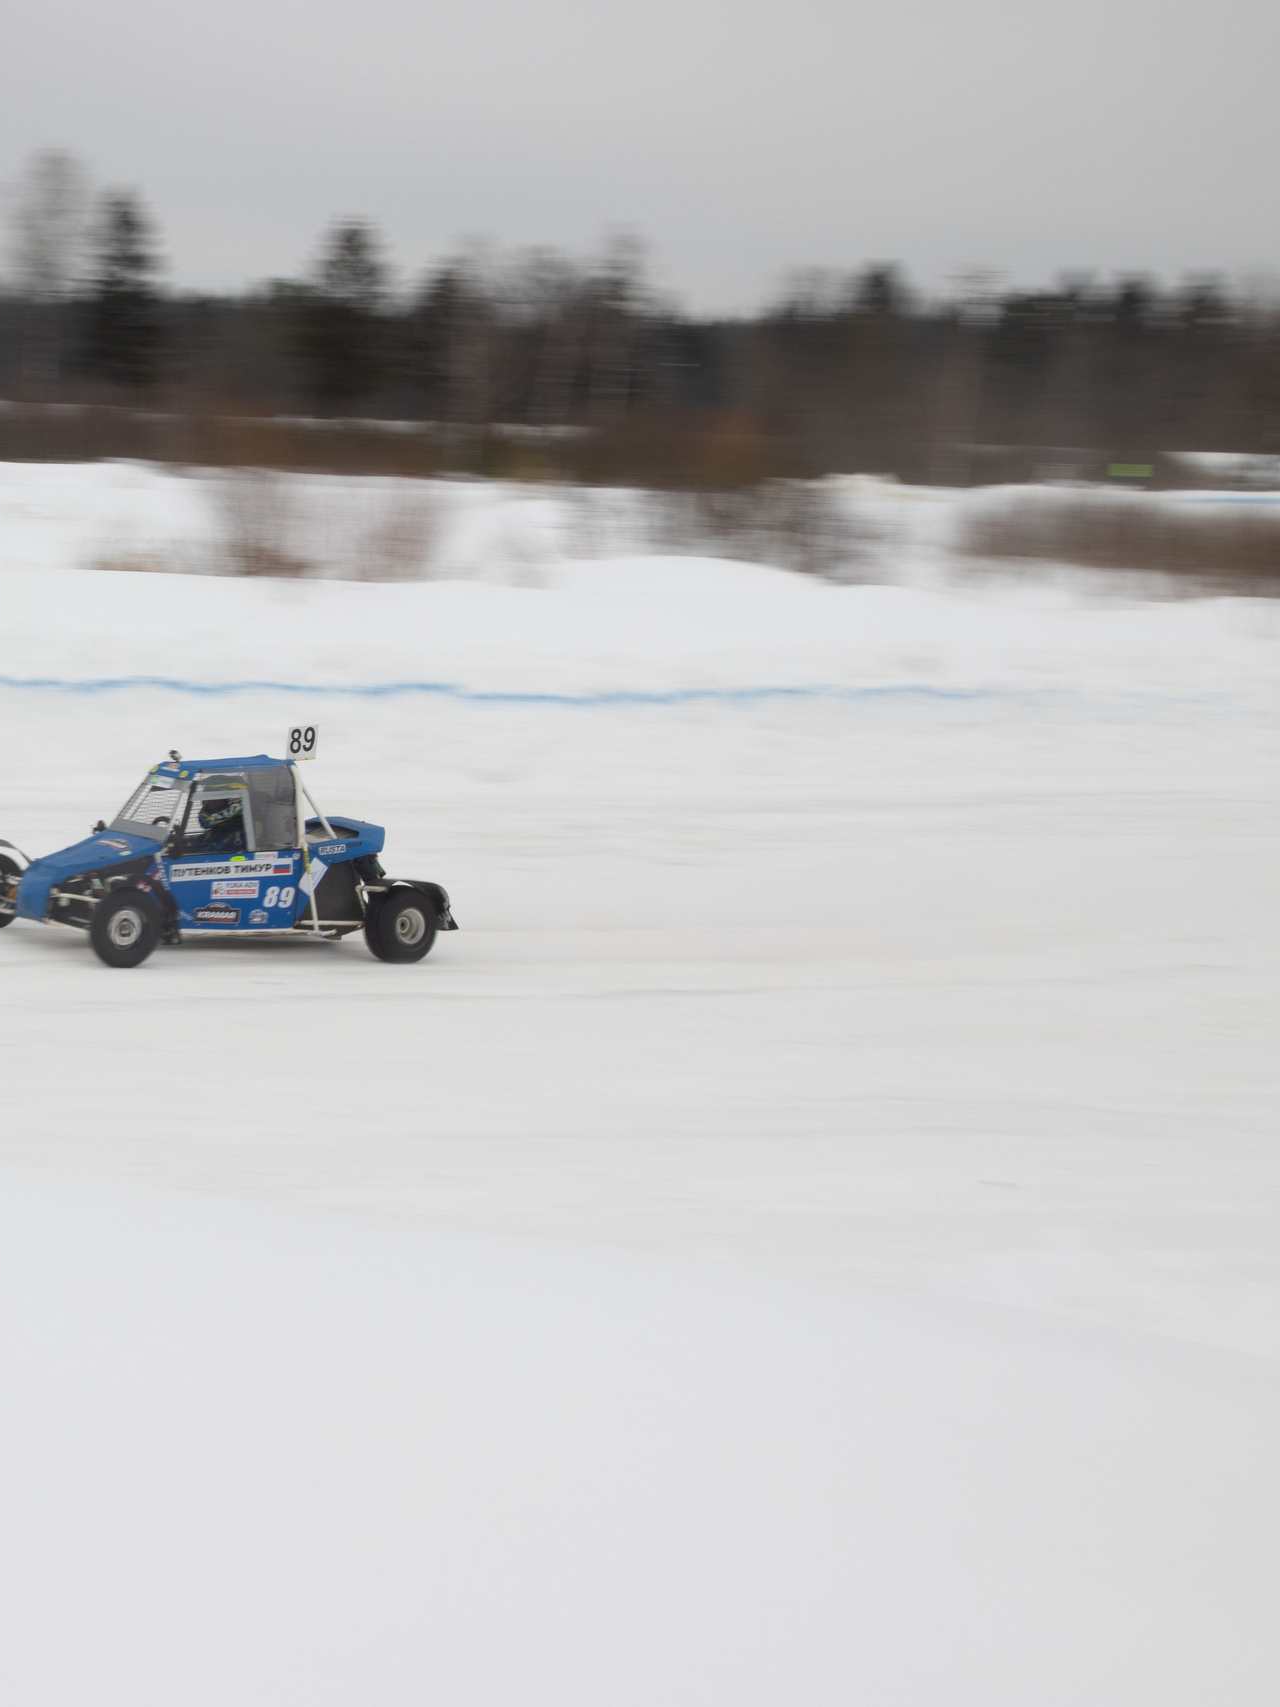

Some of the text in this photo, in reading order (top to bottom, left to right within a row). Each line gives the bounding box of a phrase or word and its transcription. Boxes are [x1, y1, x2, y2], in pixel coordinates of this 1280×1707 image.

[290, 726, 315, 754] 89
[320, 845, 345, 855] RUSTA
[172, 865, 231, 878] ПУТЕНКОВ
[234, 863, 272, 874] ТИМУР
[263, 886, 296, 909] 89
[197, 910, 237, 920] KRAMAR
